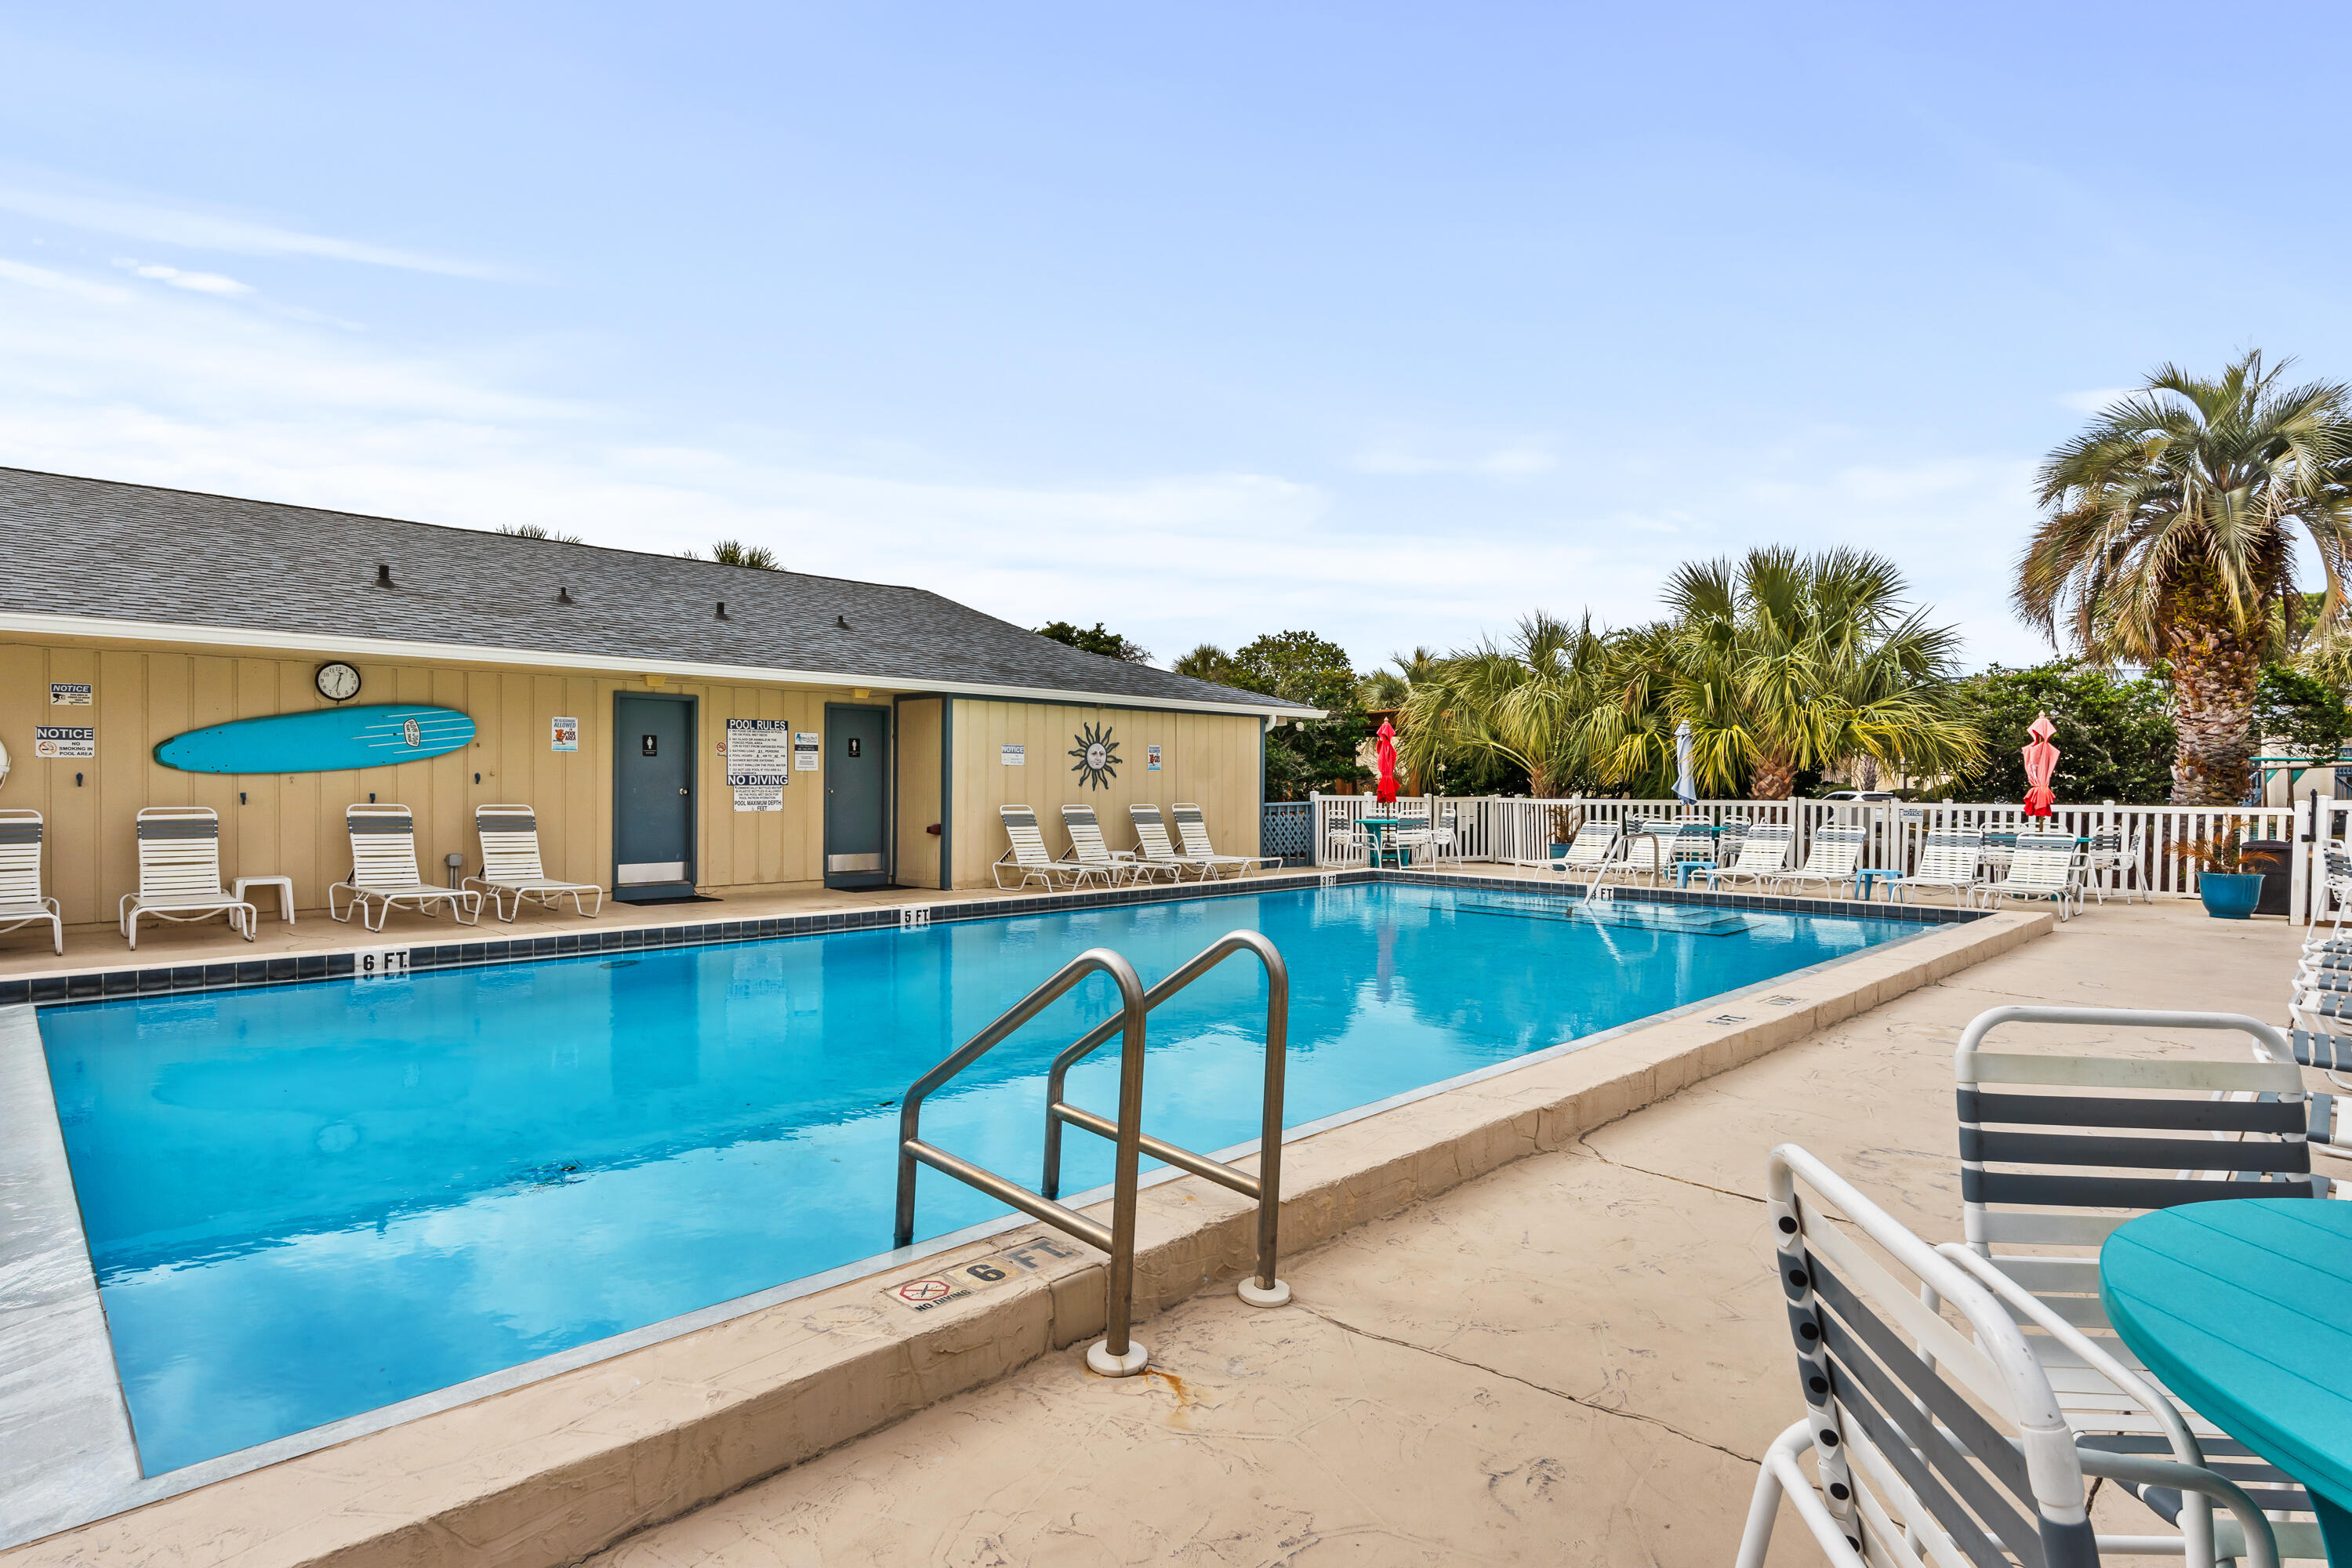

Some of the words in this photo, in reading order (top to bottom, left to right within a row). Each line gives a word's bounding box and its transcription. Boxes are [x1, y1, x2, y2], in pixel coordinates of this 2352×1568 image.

[730, 720, 754, 729] POOL
[757, 721, 785, 730] RULES
[37, 729, 93, 738] NOTICE
[728, 776, 745, 784] NO
[749, 776, 788, 784] DIVING
[1322, 876, 1326, 885] 3
[1601, 888, 1612, 899] FT.
[905, 911, 911, 922] 5
[916, 909, 928, 922] FT.
[363, 955, 374, 971] 6
[384, 952, 407, 969] FT.
[966, 1264, 1006, 1282] 6
[1006, 1240, 1073, 1268] FT.
[914, 1301, 934, 1312] NO
[934, 1289, 972, 1305] DIVING
